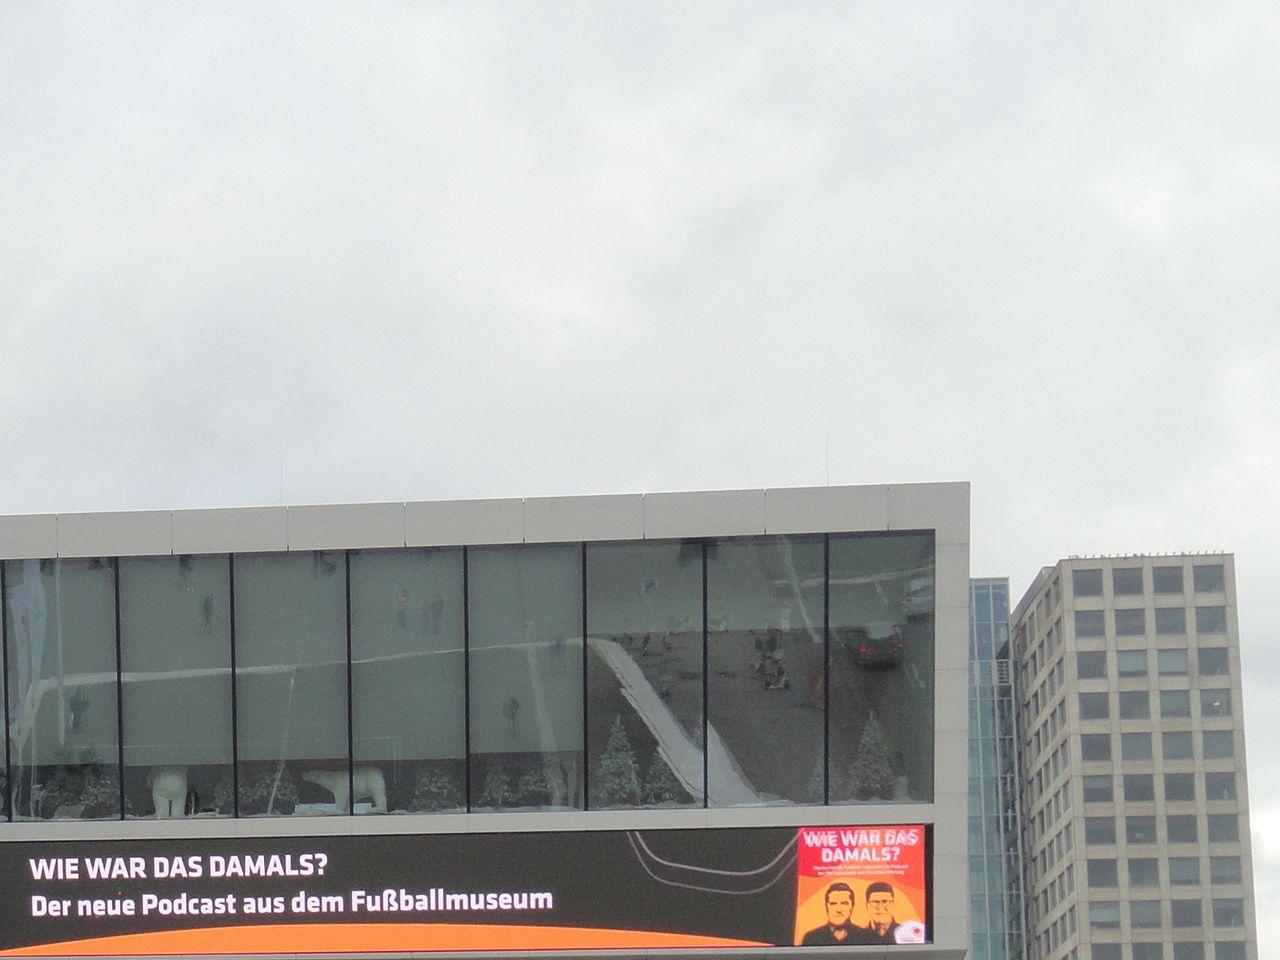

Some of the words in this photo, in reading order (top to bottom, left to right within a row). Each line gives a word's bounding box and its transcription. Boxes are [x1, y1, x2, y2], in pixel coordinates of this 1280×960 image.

[803, 830, 838, 847] WIE
[840, 830, 881, 847] WAR
[883, 829, 919, 846] DAS
[821, 846, 901, 863] DAMALS?
[28, 858, 80, 880] WIE
[84, 857, 148, 879] WAR
[153, 855, 203, 878] DAS
[209, 853, 328, 877] DAMALS?
[31, 895, 72, 917] Der
[77, 899, 136, 916] neue
[142, 892, 237, 915] Podcast
[243, 896, 285, 914] aus
[291, 890, 344, 914] dem
[351, 887, 553, 912] Fußballmuseum
